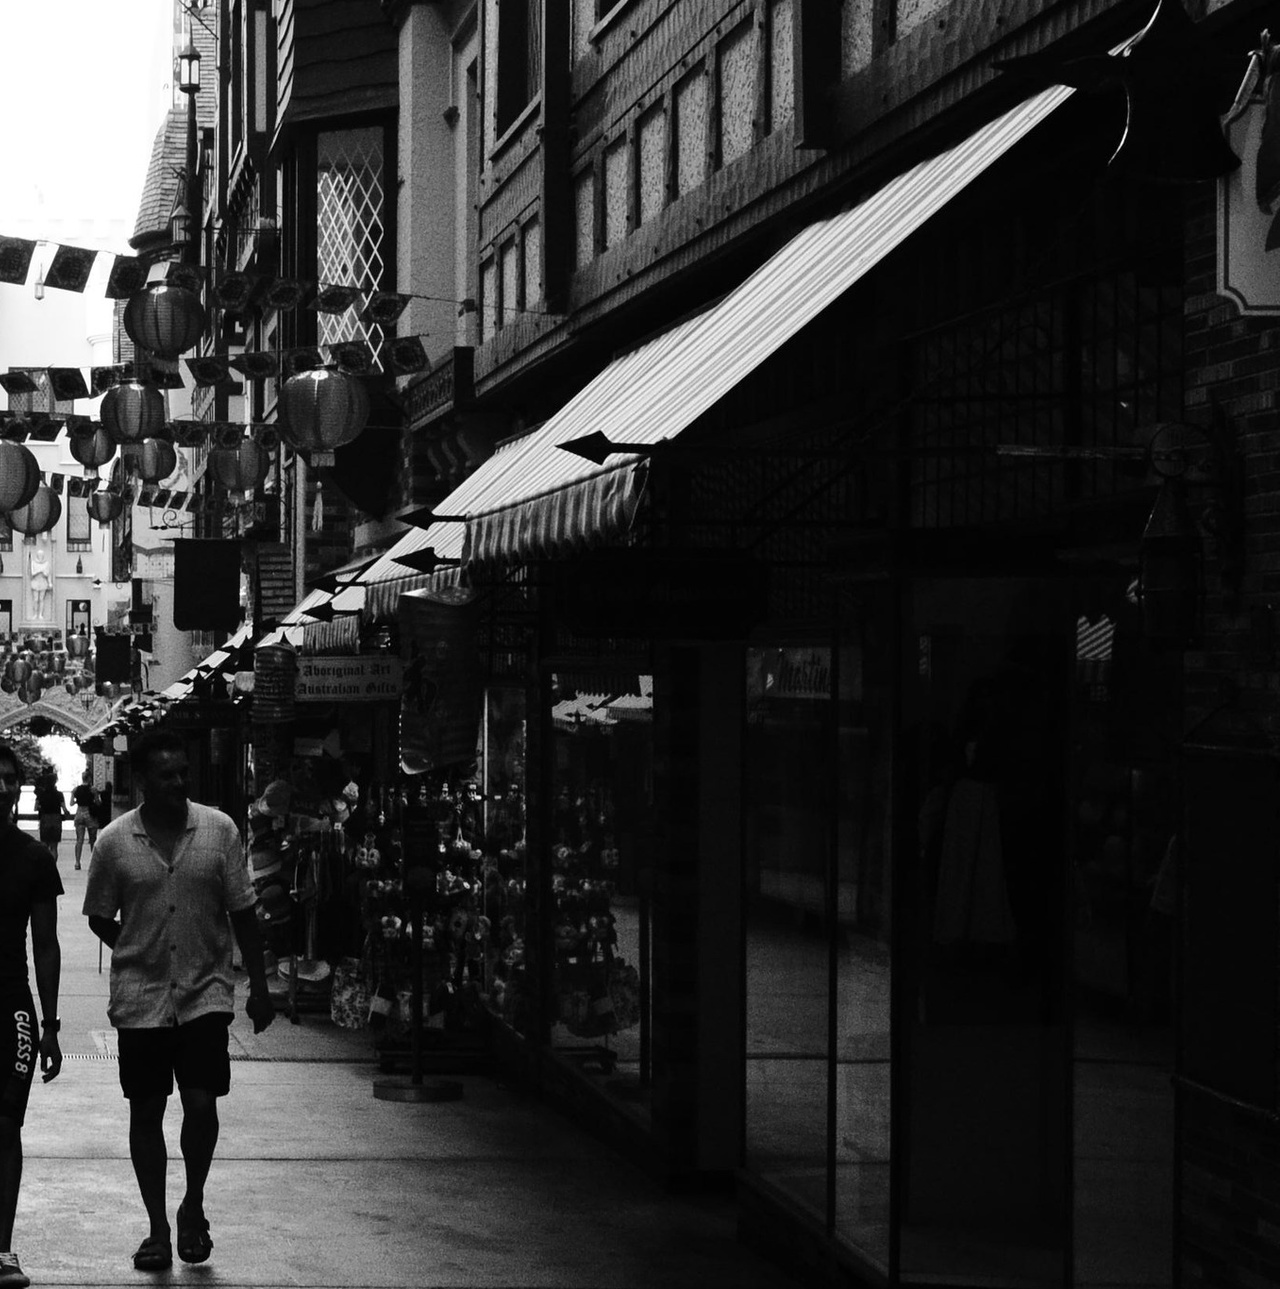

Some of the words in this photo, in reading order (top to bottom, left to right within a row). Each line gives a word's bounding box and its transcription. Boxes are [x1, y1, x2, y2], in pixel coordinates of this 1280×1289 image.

[302, 663, 366, 678] Aboriginal
[370, 663, 391, 676] Art
[297, 682, 360, 695] Australian
[365, 681, 397, 695] Gifts
[13, 1009, 33, 1063] GUESS
